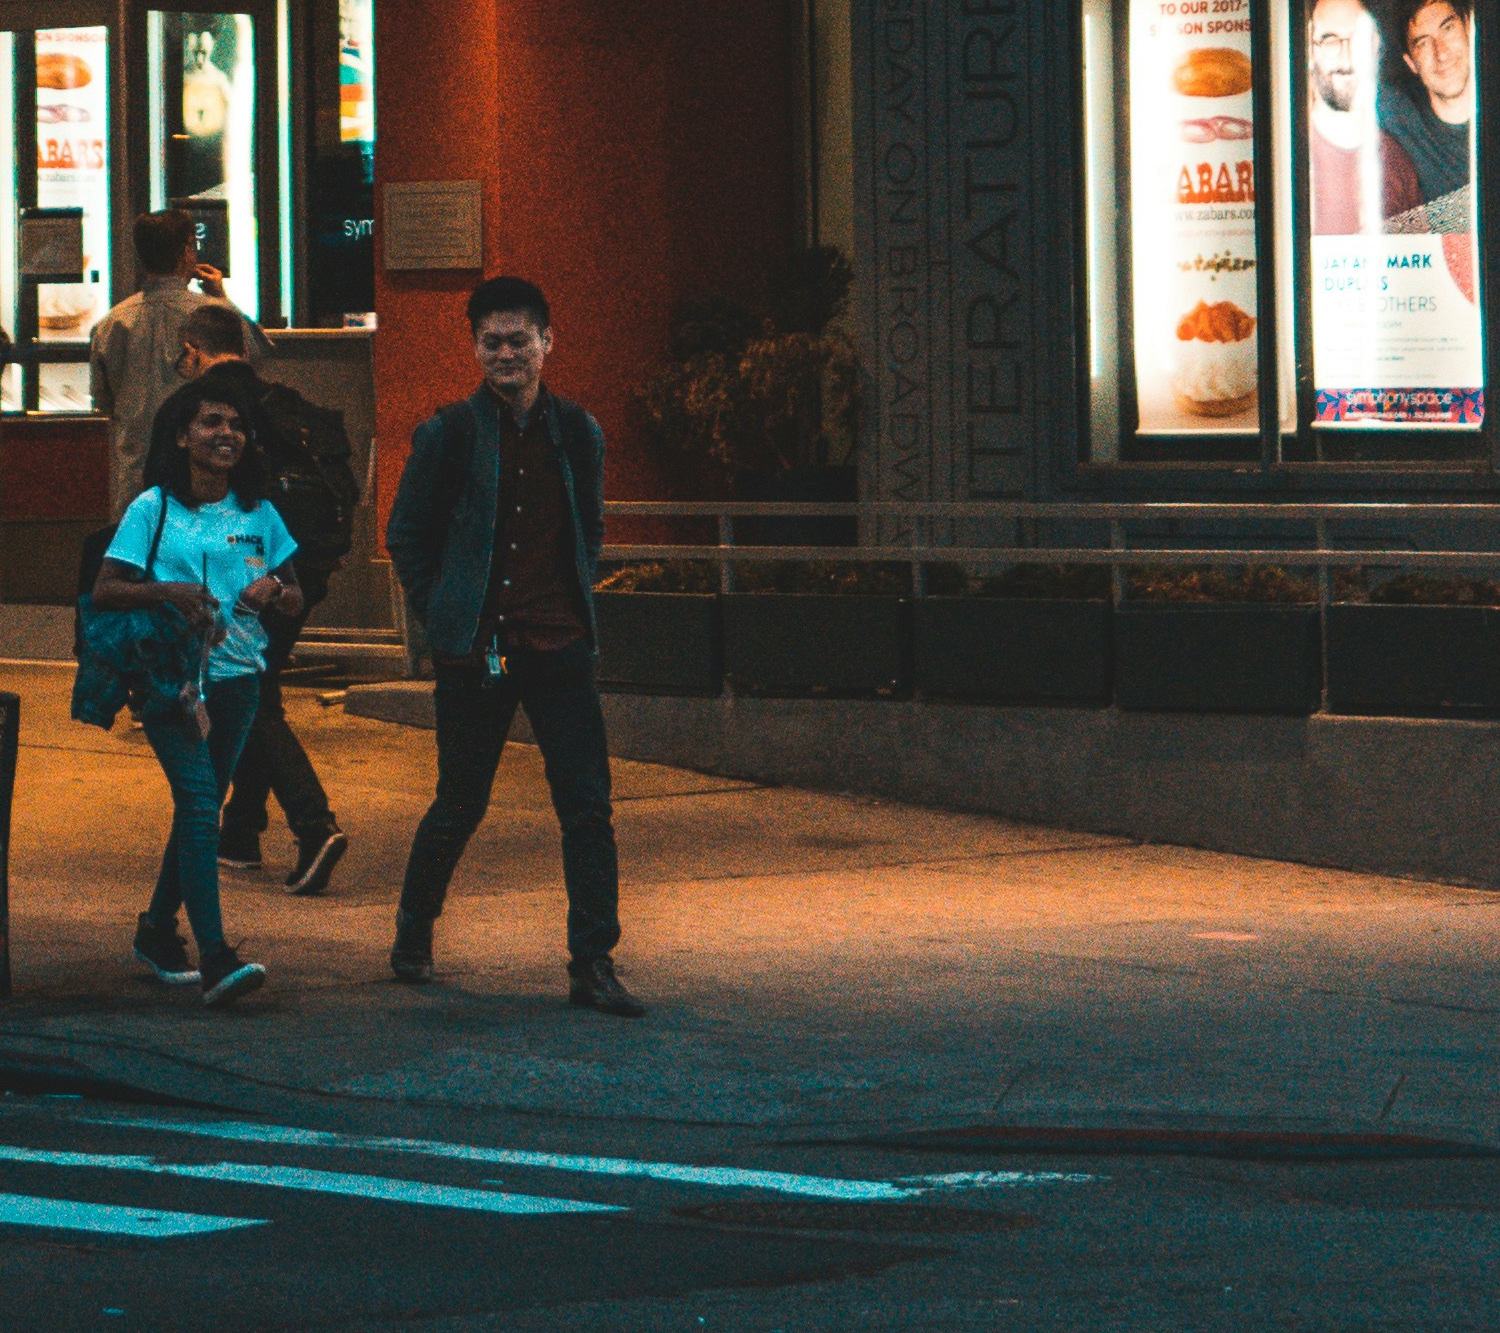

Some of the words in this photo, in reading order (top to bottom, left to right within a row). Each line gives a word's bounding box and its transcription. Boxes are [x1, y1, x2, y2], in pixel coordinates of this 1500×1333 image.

[1160, 2, 1178, 16] TO
[1180, 0, 1208, 15] OUR
[1207, 19, 1252, 34] SPONS
[1176, 160, 1255, 204] ABAR
[342, 217, 375, 242] sym
[1386, 252, 1434, 270] MARK
[1323, 275, 1390, 293] DUPLS
